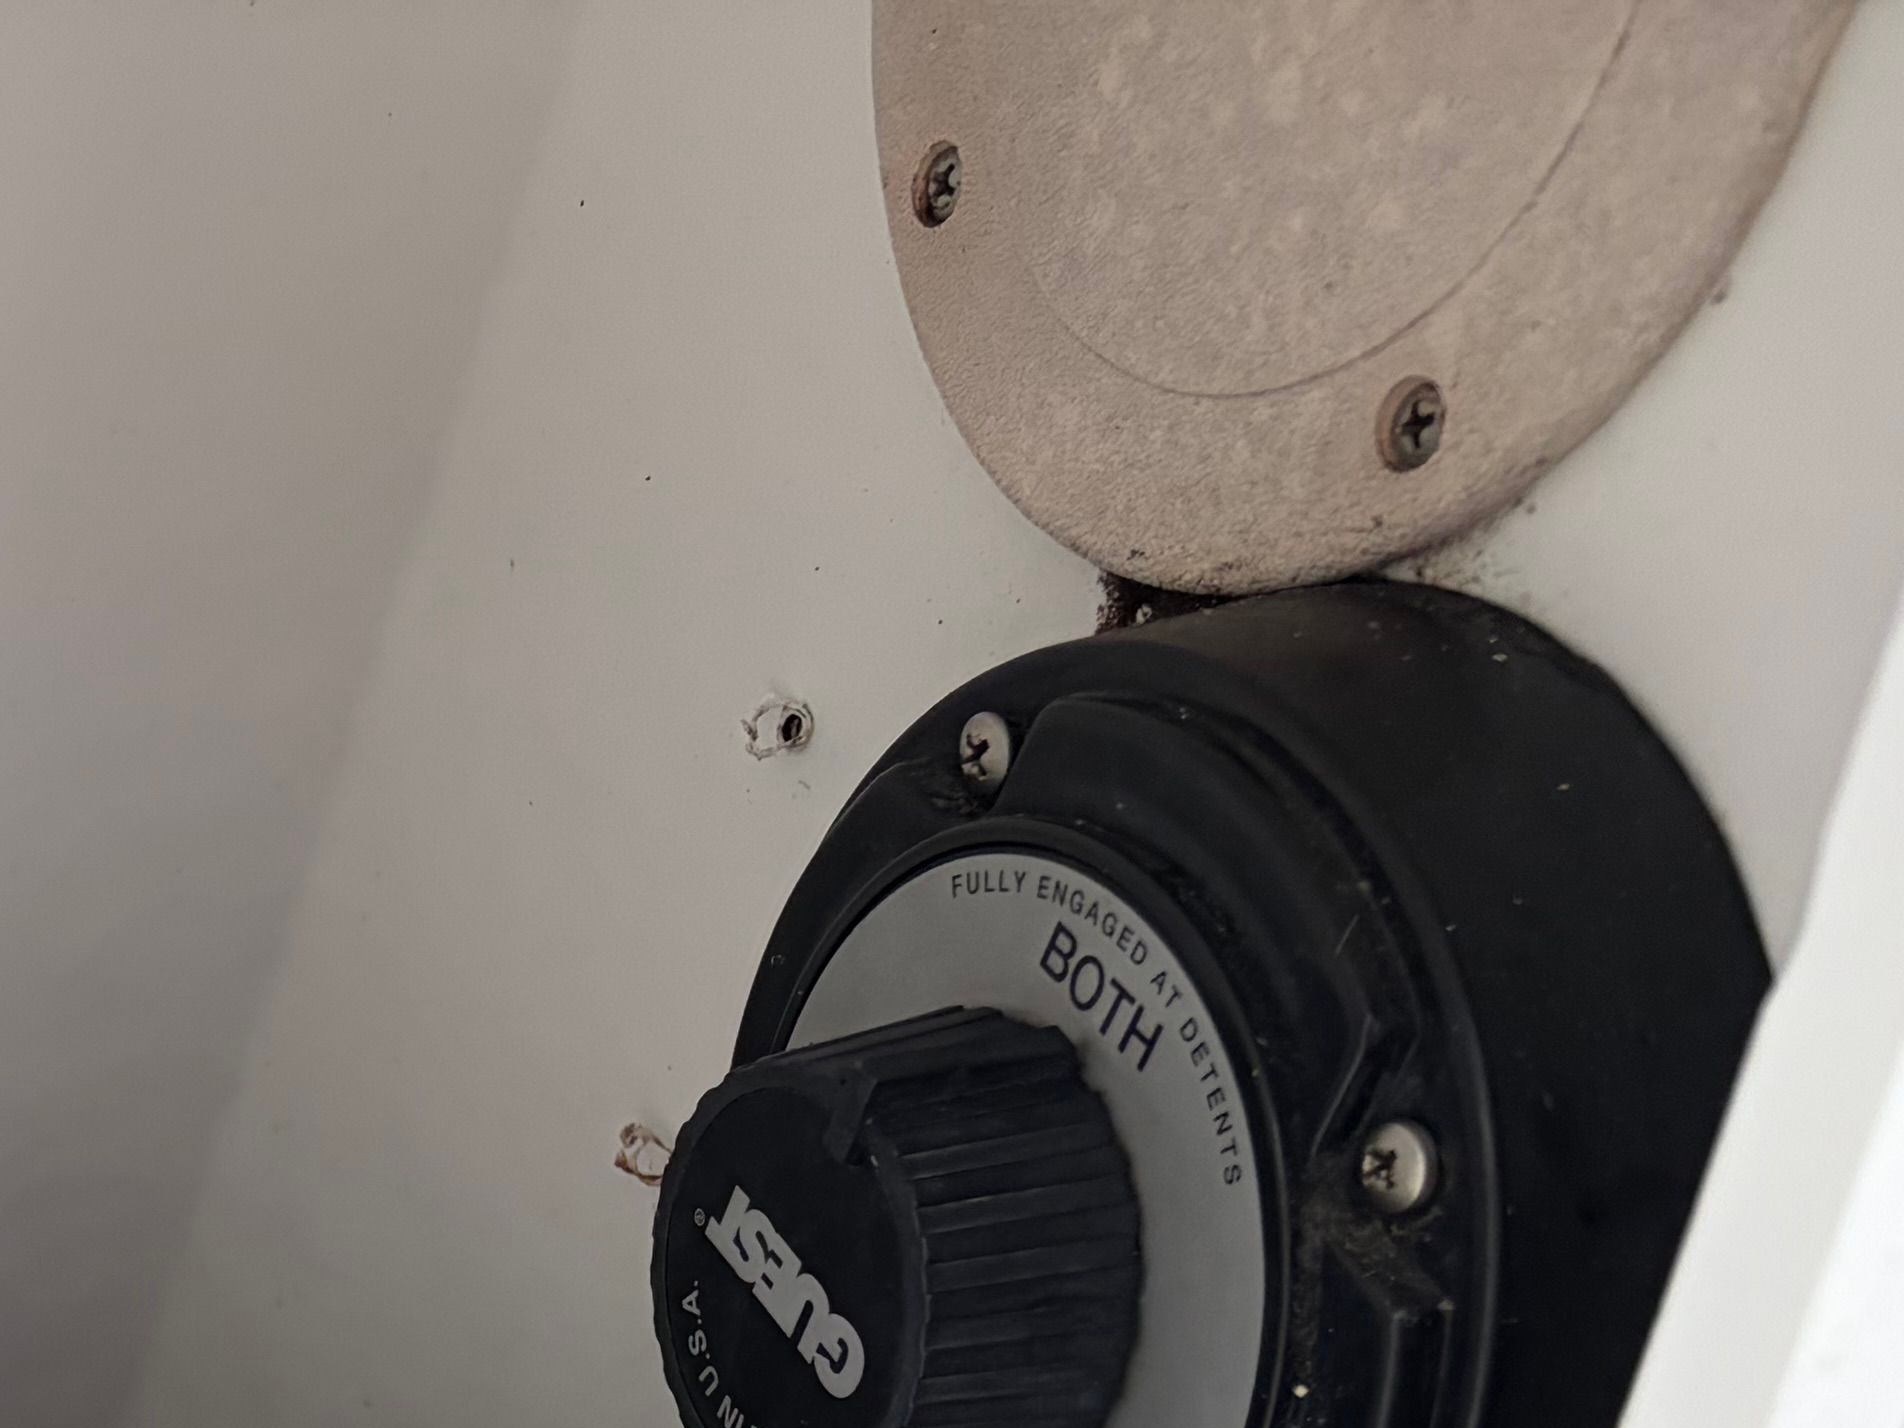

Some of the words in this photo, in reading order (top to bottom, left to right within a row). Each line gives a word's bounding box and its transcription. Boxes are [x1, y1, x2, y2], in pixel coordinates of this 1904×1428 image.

[952, 870, 1026, 898] FULLY
[1036, 874, 1148, 966] ENGAGED
[1149, 969, 1183, 1009] AT
[1178, 1016, 1242, 1186] DETENTS
[1039, 920, 1164, 1072] BOTH
[681, 1280, 719, 1397] U.S.A.
[704, 1185, 865, 1399] GUEST
